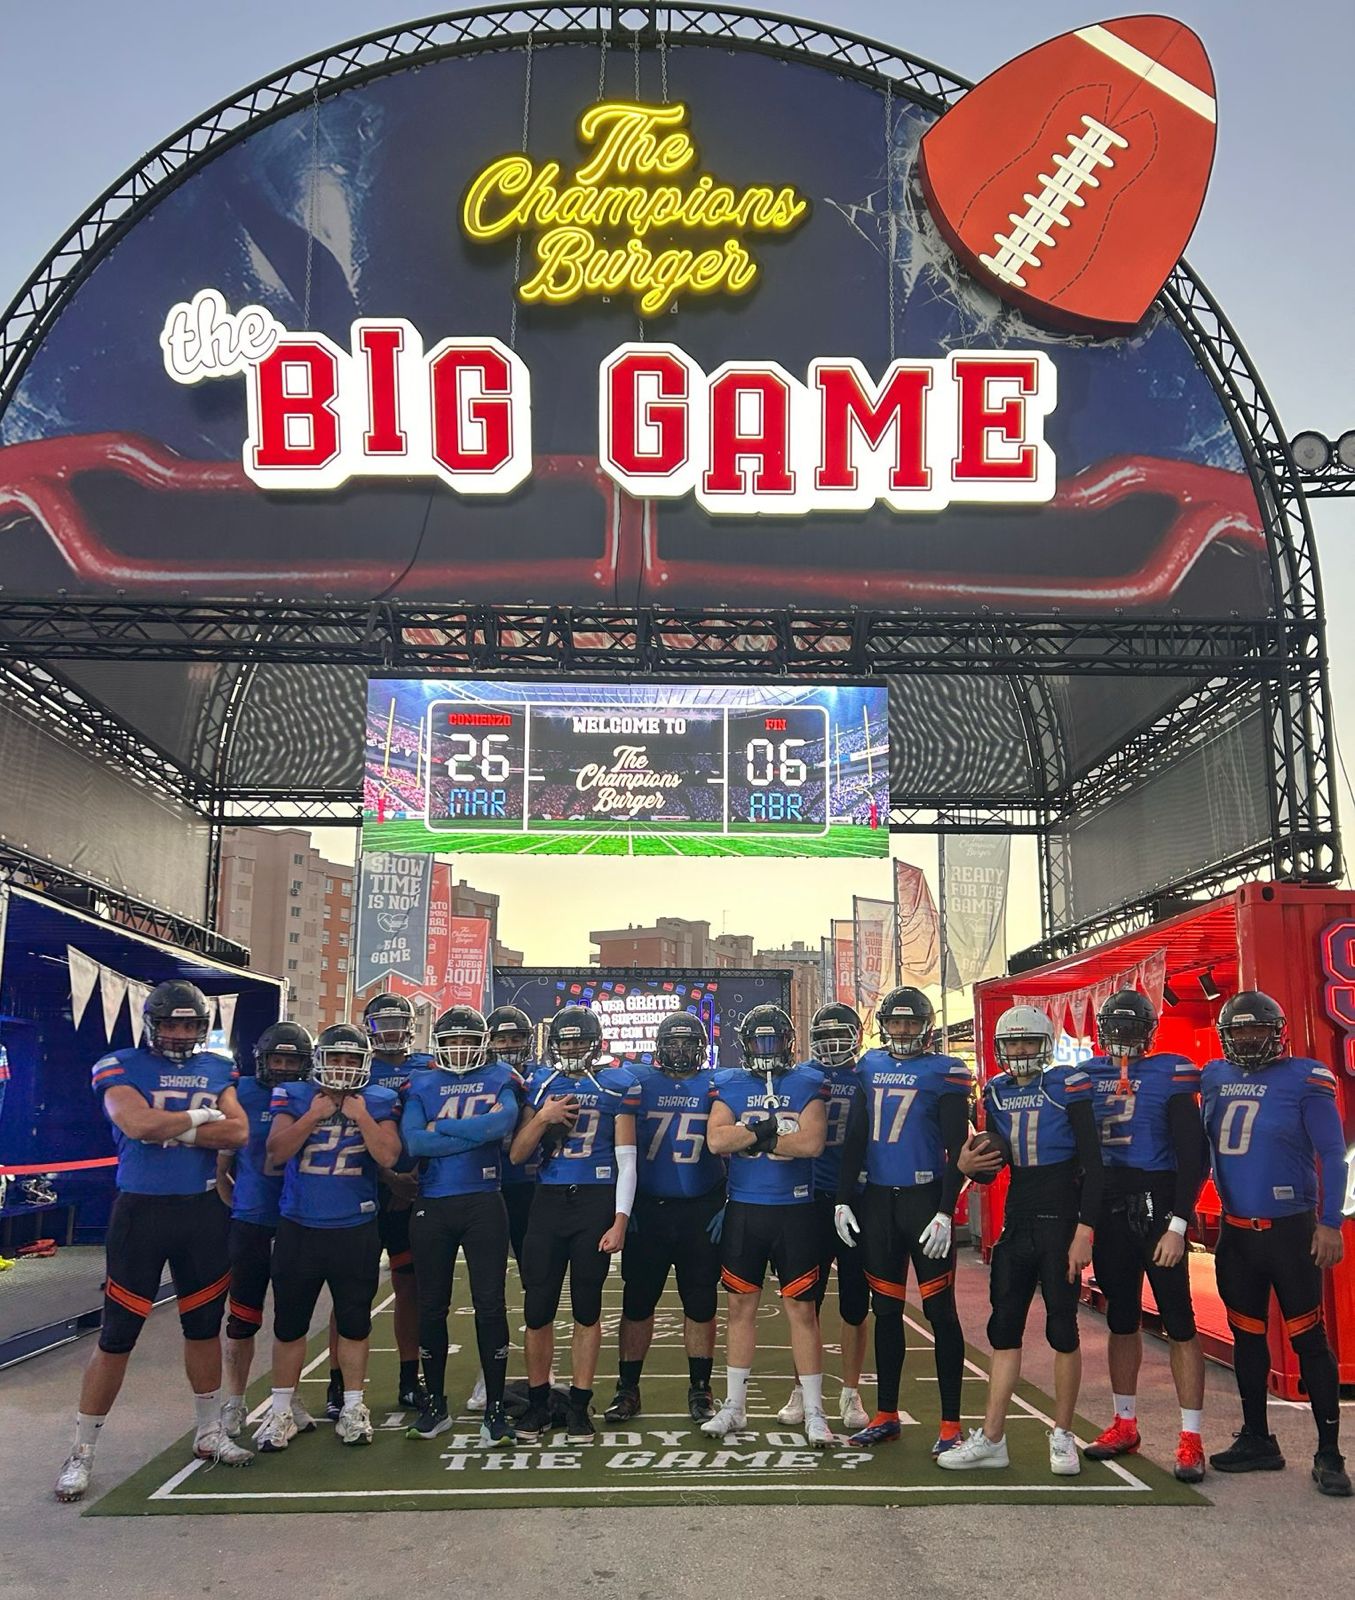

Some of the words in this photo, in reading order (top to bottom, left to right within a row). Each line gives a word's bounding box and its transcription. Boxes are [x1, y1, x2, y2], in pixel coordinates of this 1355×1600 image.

[580, 102, 693, 184] The
[463, 158, 807, 239] Champions
[519, 226, 757, 313] Burger
[168, 294, 278, 376] the
[250, 322, 516, 476] BIG
[604, 349, 1042, 498] GAME
[448, 713, 512, 726] COMIENZO
[572, 716, 660, 734] WELCOME
[664, 718, 687, 735] TO
[765, 719, 787, 731] FIN
[447, 733, 510, 782] 26
[610, 745, 650, 773] The
[746, 738, 807, 787] 06
[575, 763, 683, 791] Champions
[449, 788, 505, 817] MAR
[592, 787, 667, 817] Burger
[750, 793, 802, 821] ABR
[371, 855, 424, 876] SHOW
[950, 866, 1005, 884] READY
[370, 874, 422, 895] TIME
[951, 883, 977, 898] FOR
[981, 884, 1004, 900] THE
[368, 895, 384, 909] IS
[388, 894, 420, 911] NOW
[371, 949, 411, 964] GAME
[626, 995, 680, 1011] GRATIS
[160, 1075, 209, 1089] SHARKS
[440, 1082, 485, 1096] SHARKS
[872, 1072, 917, 1086] SHARKS
[1219, 1083, 1268, 1098] SHARKS
[657, 1096, 699, 1108] SHARKS
[1001, 1094, 1045, 1111] SHARKS
[873, 1087, 918, 1143] 17
[1101, 1094, 1137, 1146] 2
[646, 1111, 710, 1164] 75
[1009, 1110, 1040, 1167] 11
[1218, 1099, 1260, 1156] 0
[299, 1125, 368, 1176] 22
[440, 1452, 583, 1471] THE
[604, 1450, 875, 1470] GAME?
